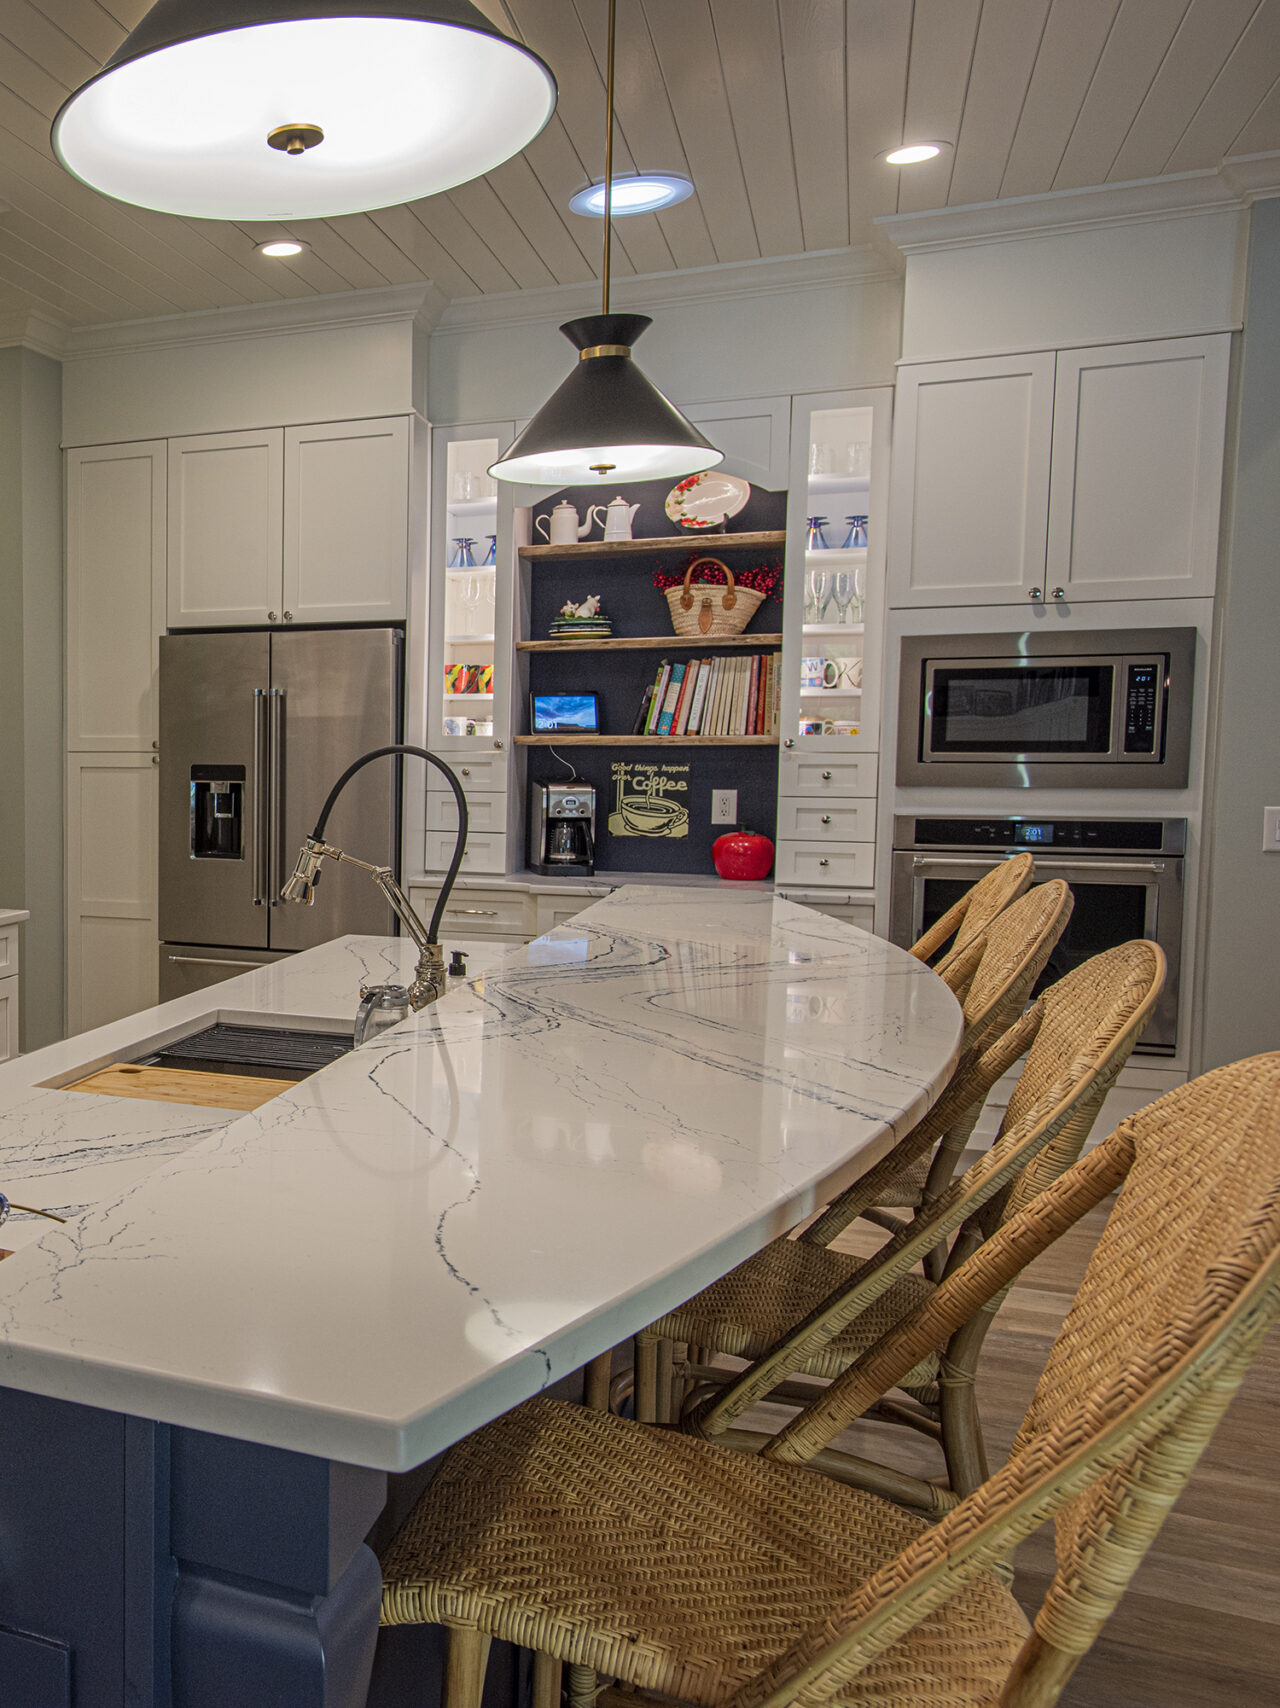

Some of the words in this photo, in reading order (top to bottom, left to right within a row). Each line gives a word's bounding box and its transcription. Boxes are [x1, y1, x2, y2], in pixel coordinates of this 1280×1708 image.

[538, 719, 558, 729] 2:01
[611, 763, 633, 771] Good
[634, 764, 658, 775] things
[661, 764, 690, 773] happen
[632, 776, 688, 796] Coffee
